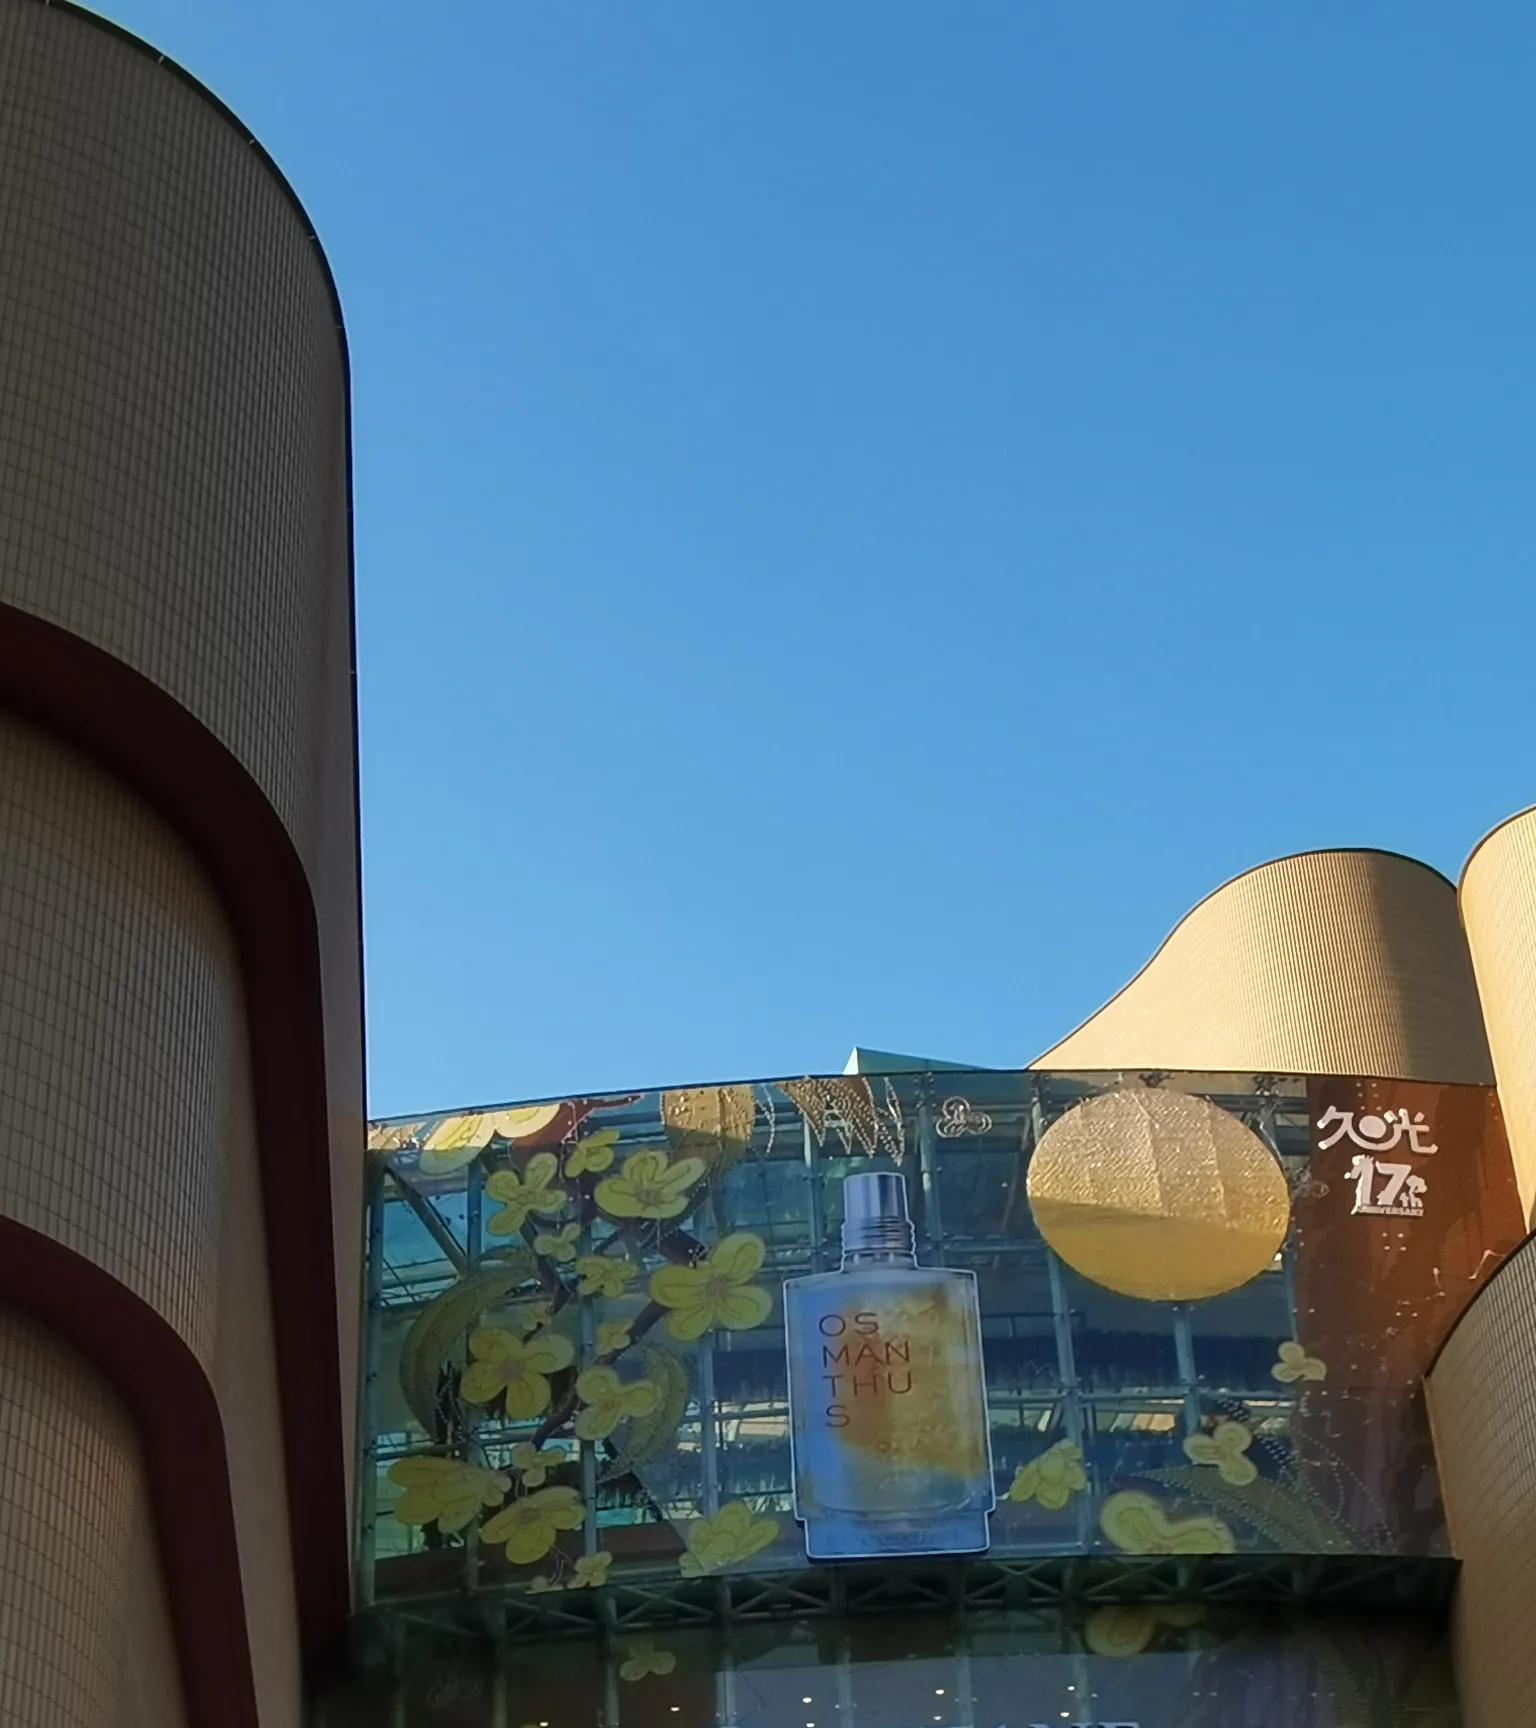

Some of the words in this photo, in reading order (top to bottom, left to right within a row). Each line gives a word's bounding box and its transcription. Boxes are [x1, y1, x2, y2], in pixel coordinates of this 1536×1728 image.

[1316, 1104, 1439, 1154] 久光
[818, 1311, 879, 1338] OS
[822, 1340, 911, 1369] MAN
[822, 1371, 913, 1398] THU
[825, 1404, 851, 1428] S
